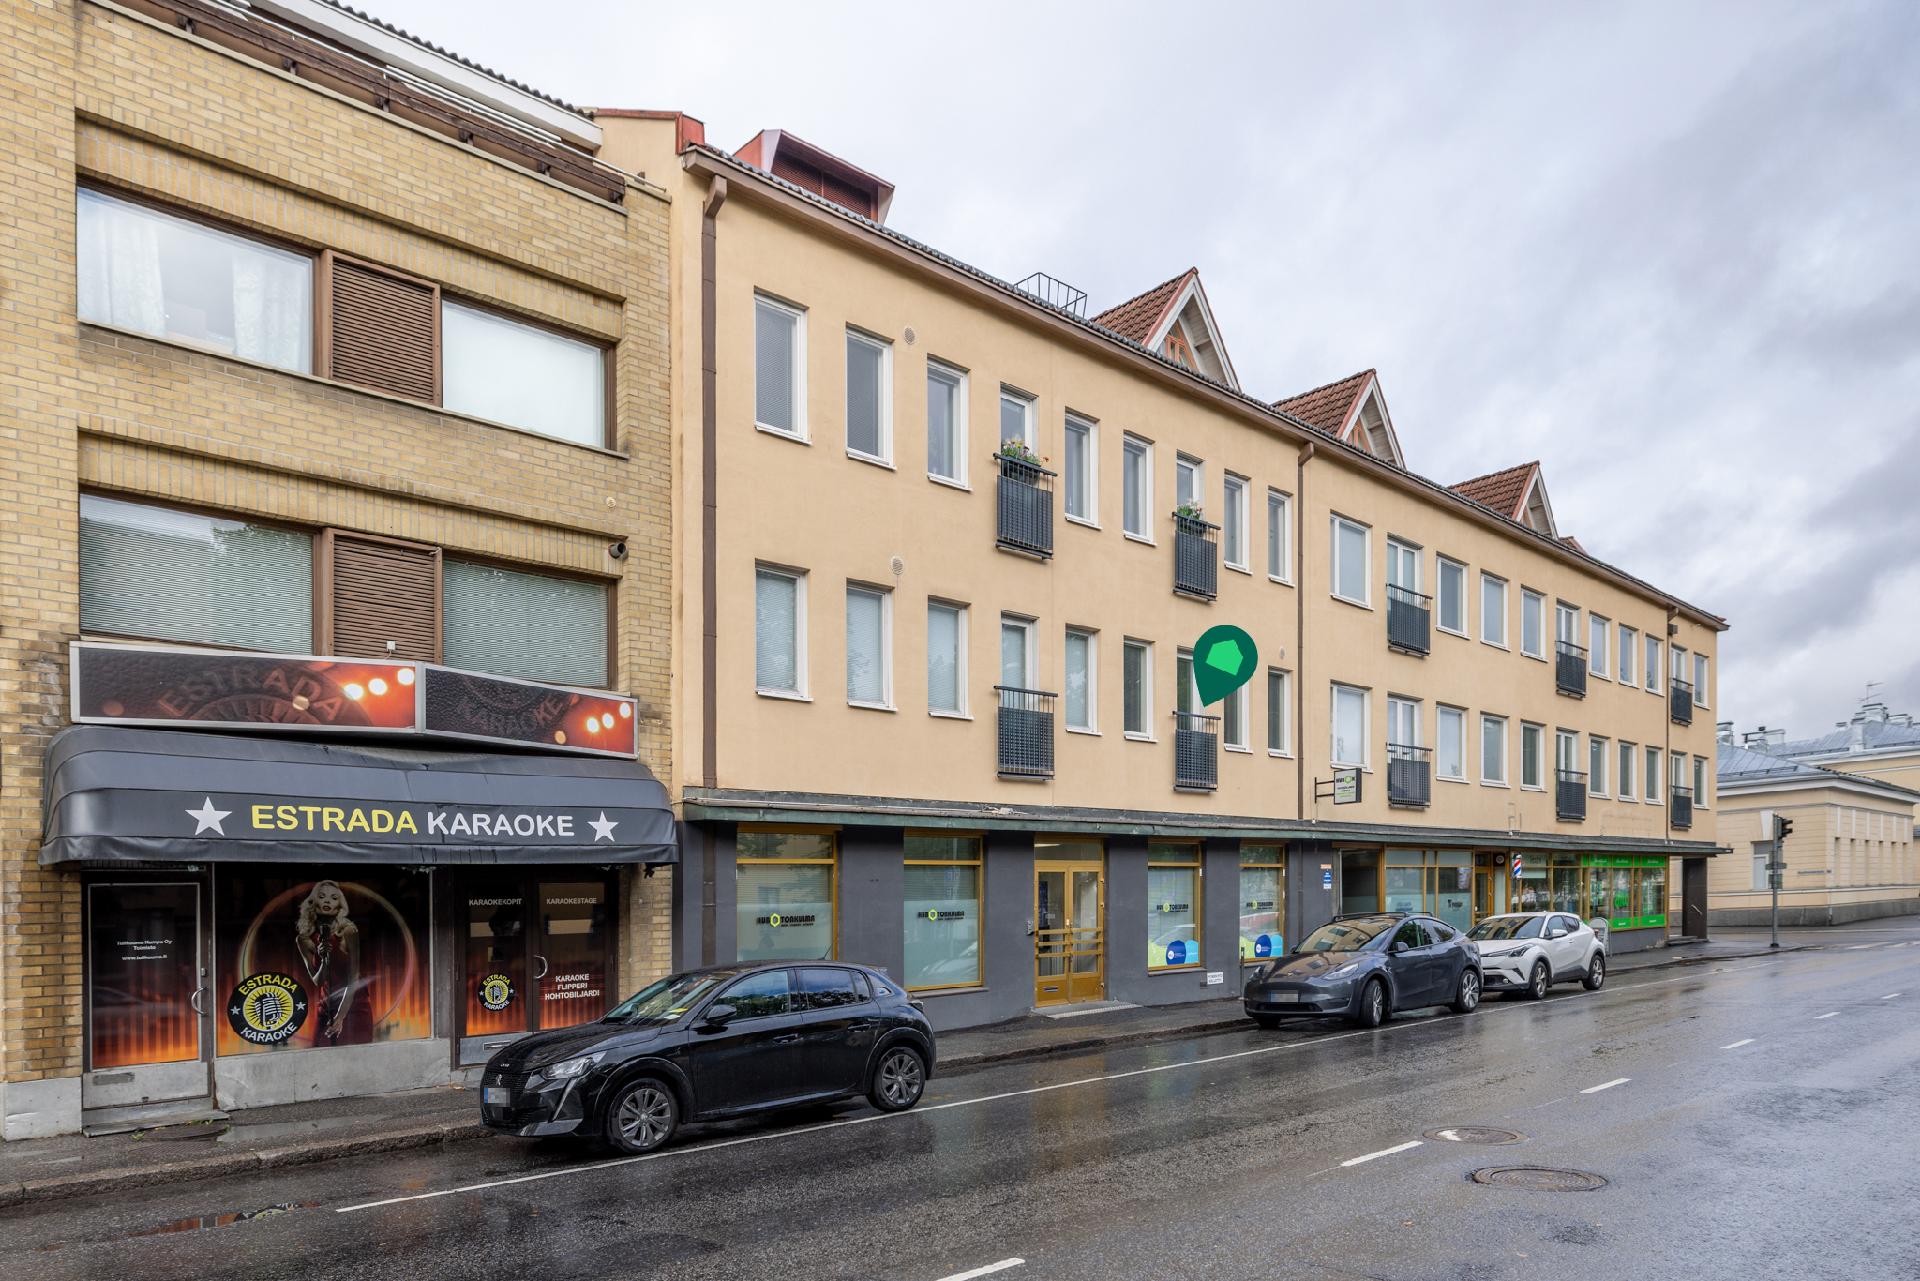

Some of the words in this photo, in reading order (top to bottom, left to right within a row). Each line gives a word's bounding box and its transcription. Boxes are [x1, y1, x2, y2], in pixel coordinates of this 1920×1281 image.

[158, 664, 344, 721] ESTRADA
[251, 804, 419, 835] ESTRADA
[426, 811, 575, 837] KARAOKE
[546, 897, 597, 905] KARAOKESTAGE
[482, 974, 511, 986] ESTRADA
[555, 973, 590, 983] KARAOKE
[238, 974, 298, 996] ESTRADA
[557, 982, 588, 991] FLIPPERI
[544, 989, 600, 1001] HOHTOBILJARDI
[483, 1000, 510, 1011] KARAOKE
[240, 1022, 298, 1042] KARAOKE
